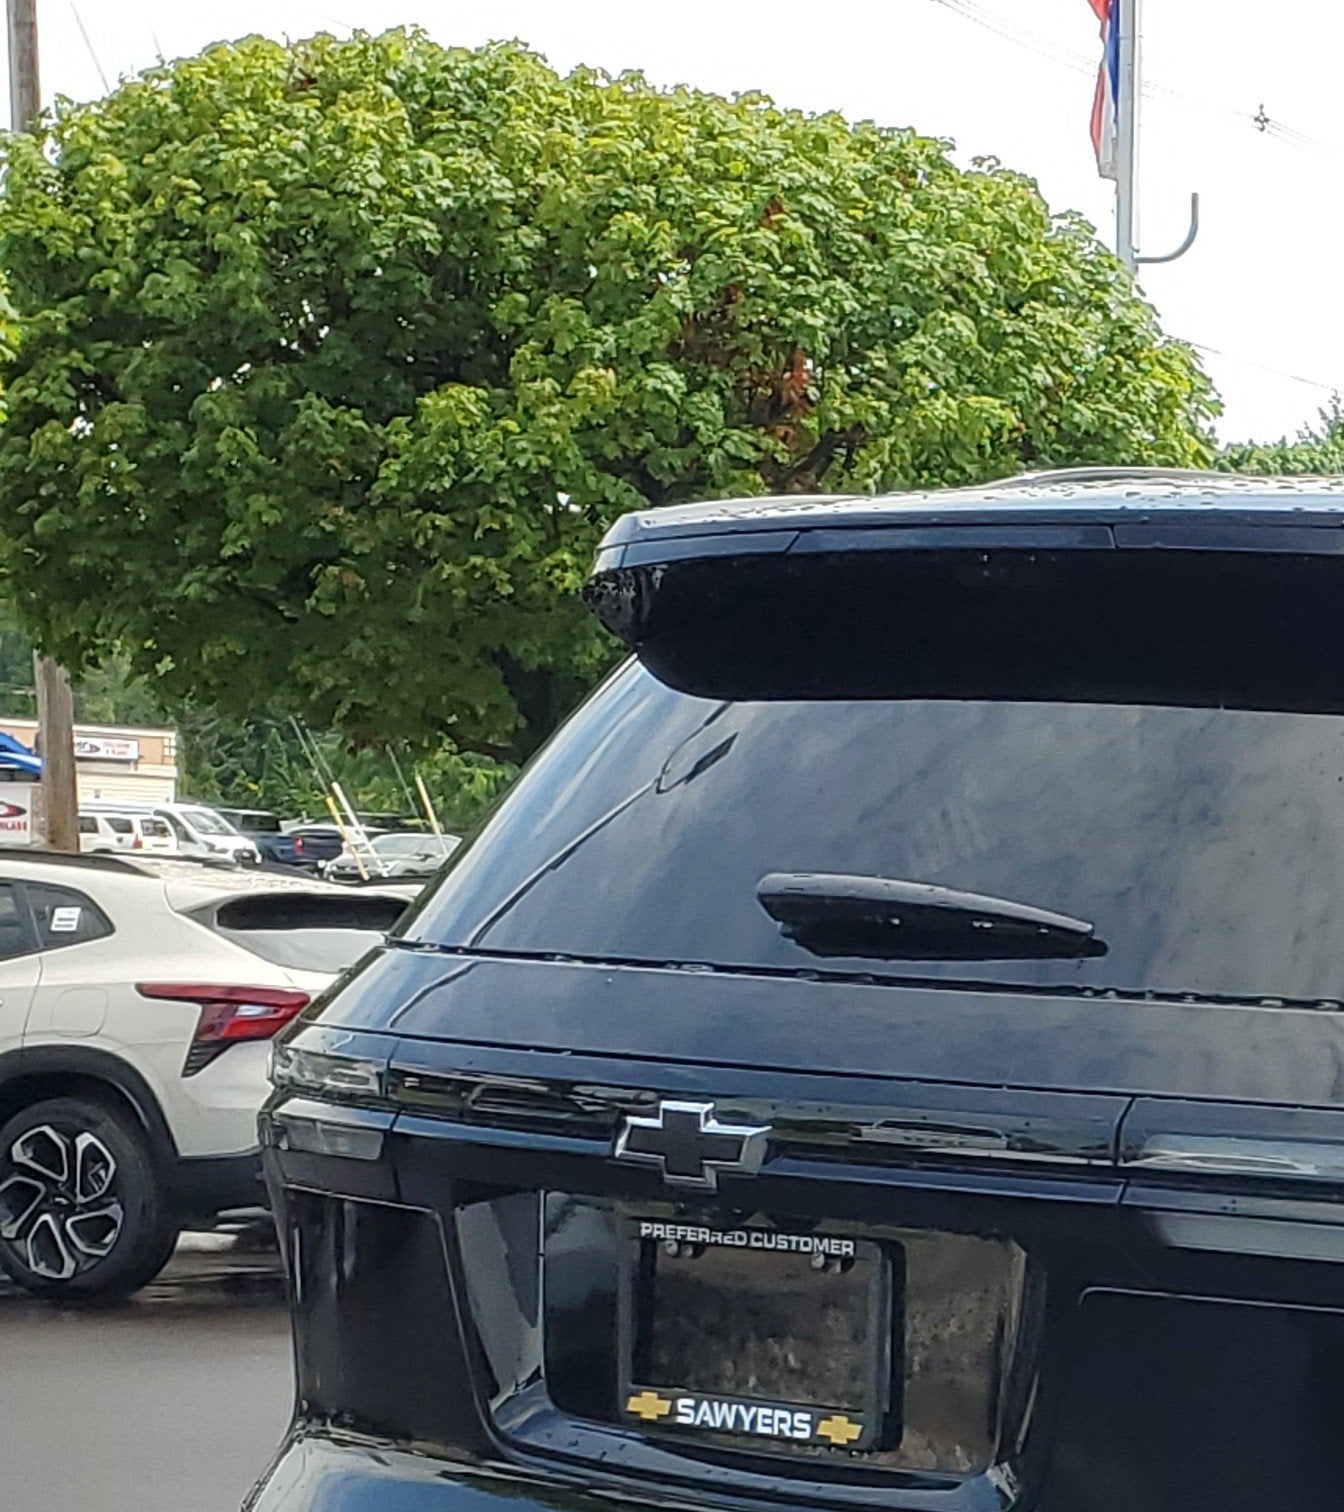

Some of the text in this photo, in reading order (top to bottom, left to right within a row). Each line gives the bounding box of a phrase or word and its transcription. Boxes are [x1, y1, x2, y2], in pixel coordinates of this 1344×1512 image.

[639, 1221, 855, 1256] PREFERRED CUSTOMER
[676, 1397, 812, 1439] SAWYERS
